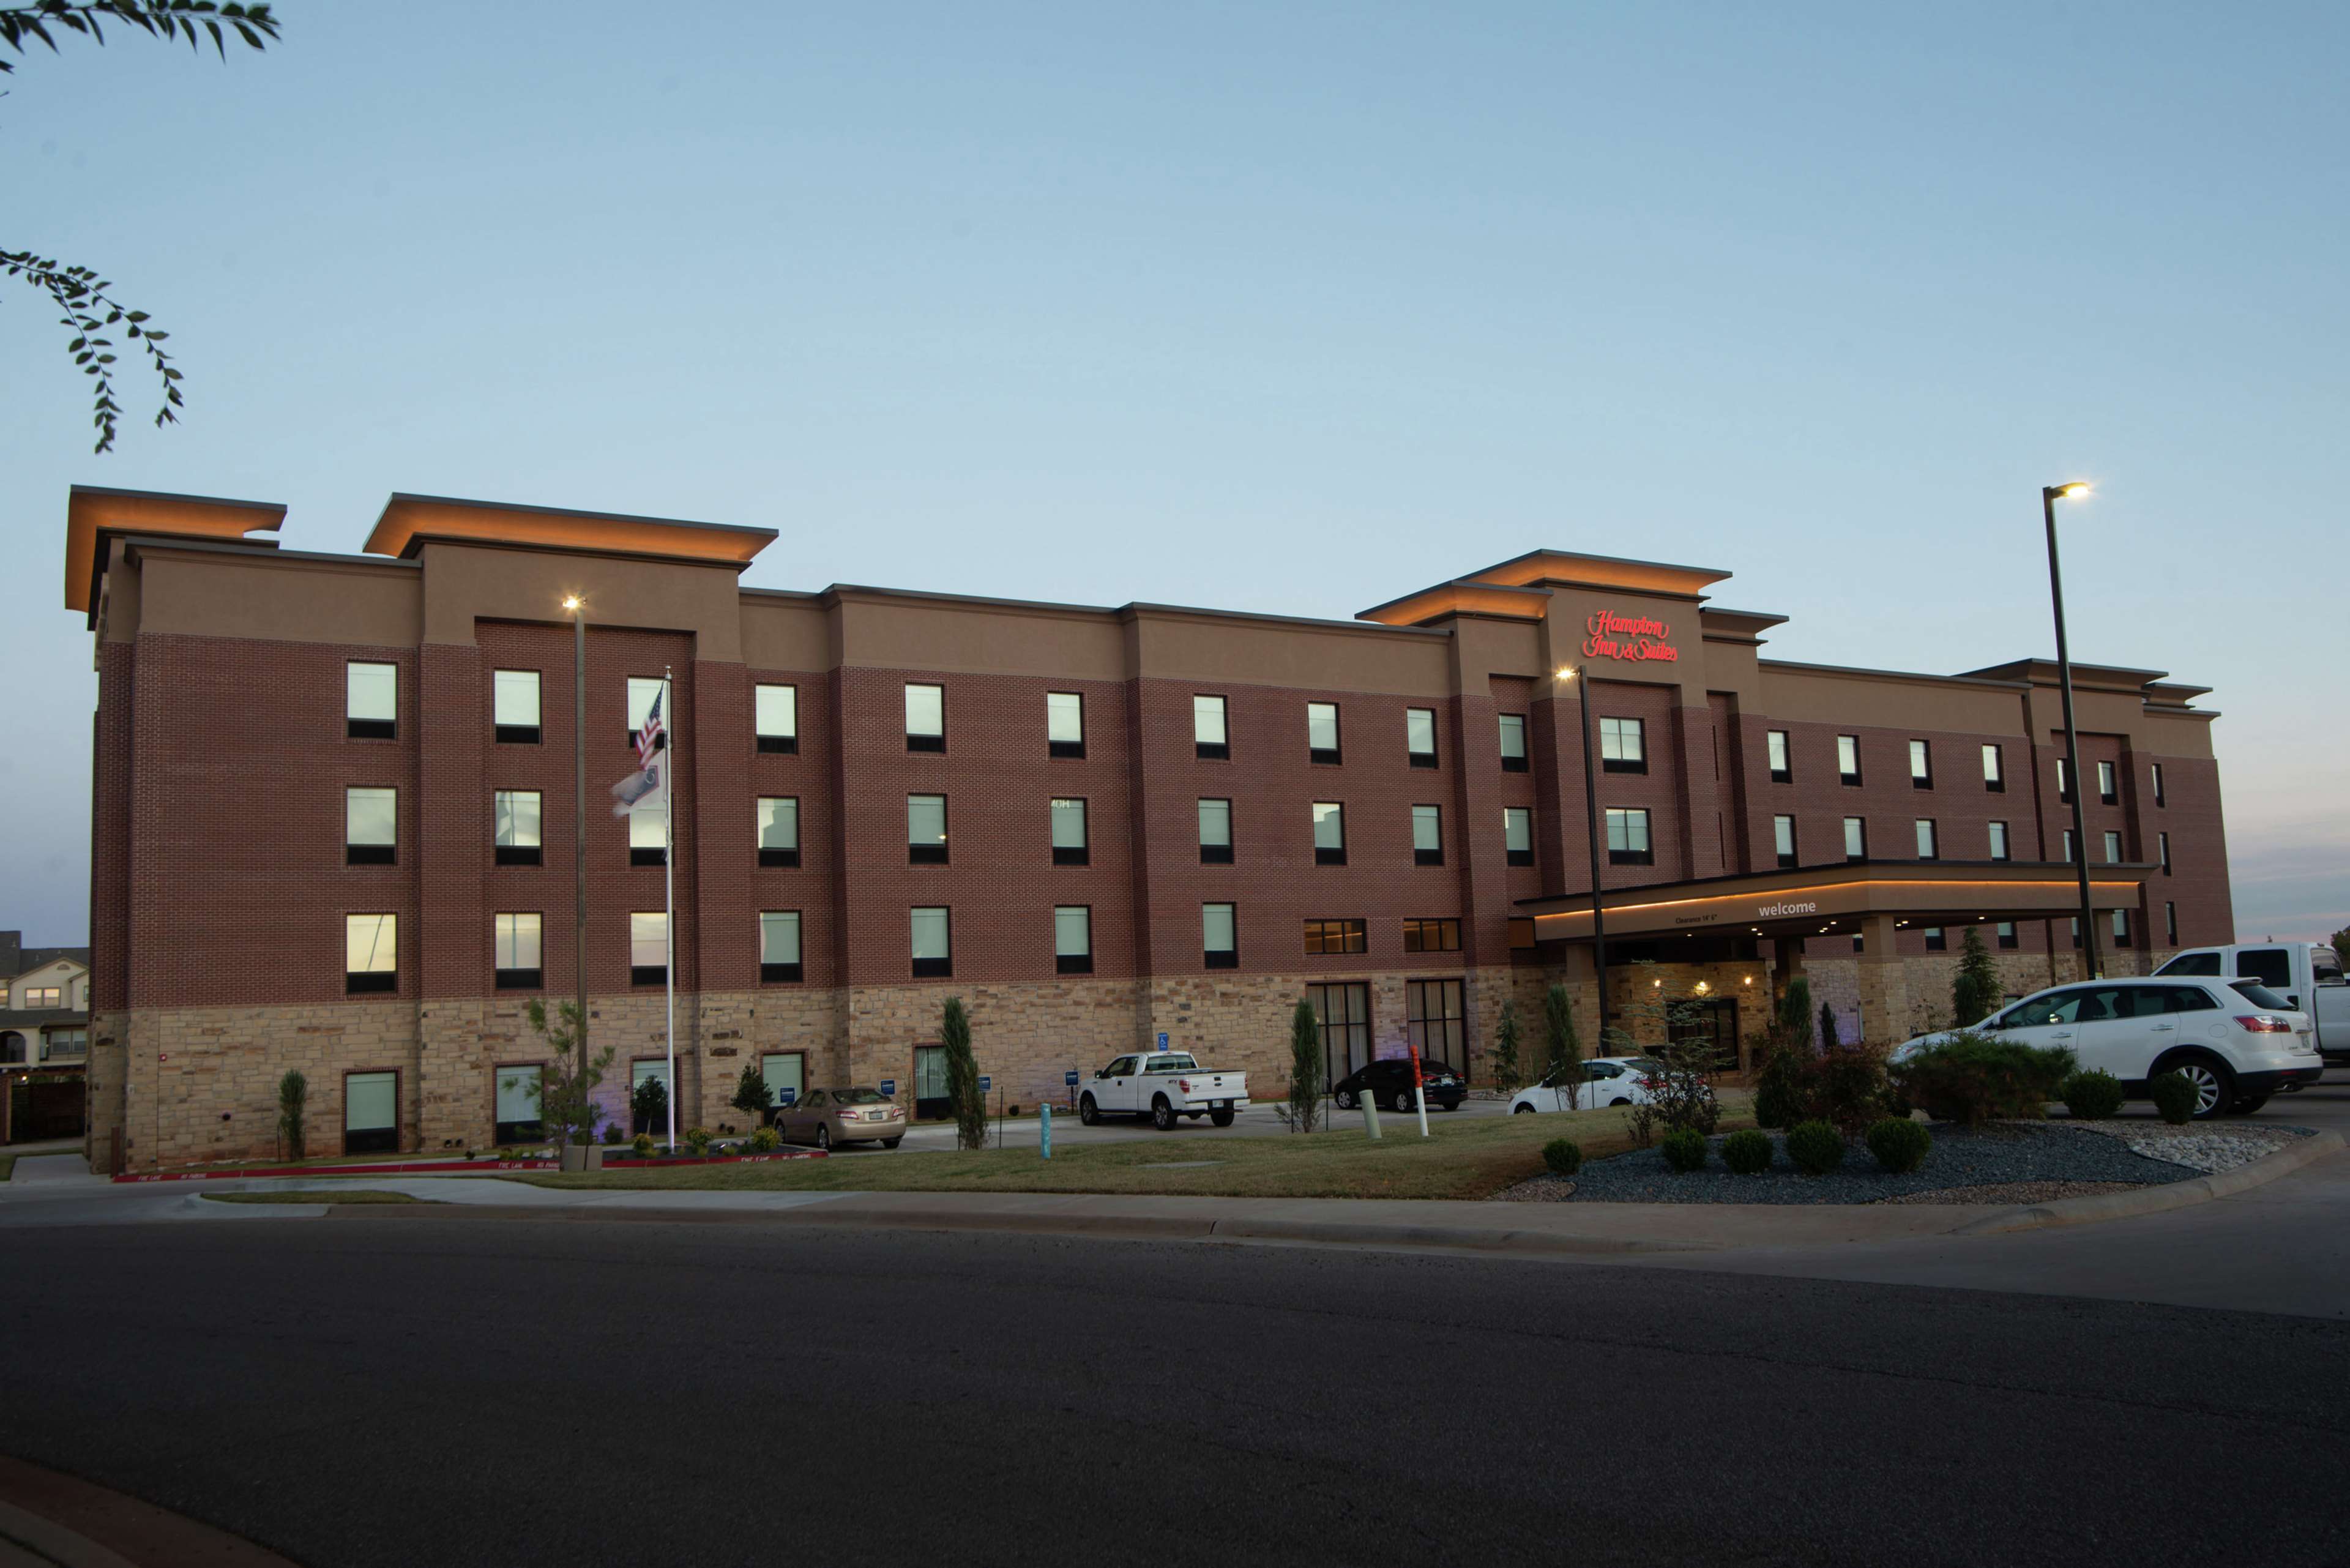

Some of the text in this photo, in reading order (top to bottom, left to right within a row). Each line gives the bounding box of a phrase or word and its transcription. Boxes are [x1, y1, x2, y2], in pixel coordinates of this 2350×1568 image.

[1587, 610, 1669, 639] Hampton
[1583, 635, 1678, 661] Inn & Suites
[1758, 902, 1816, 917] welcome
